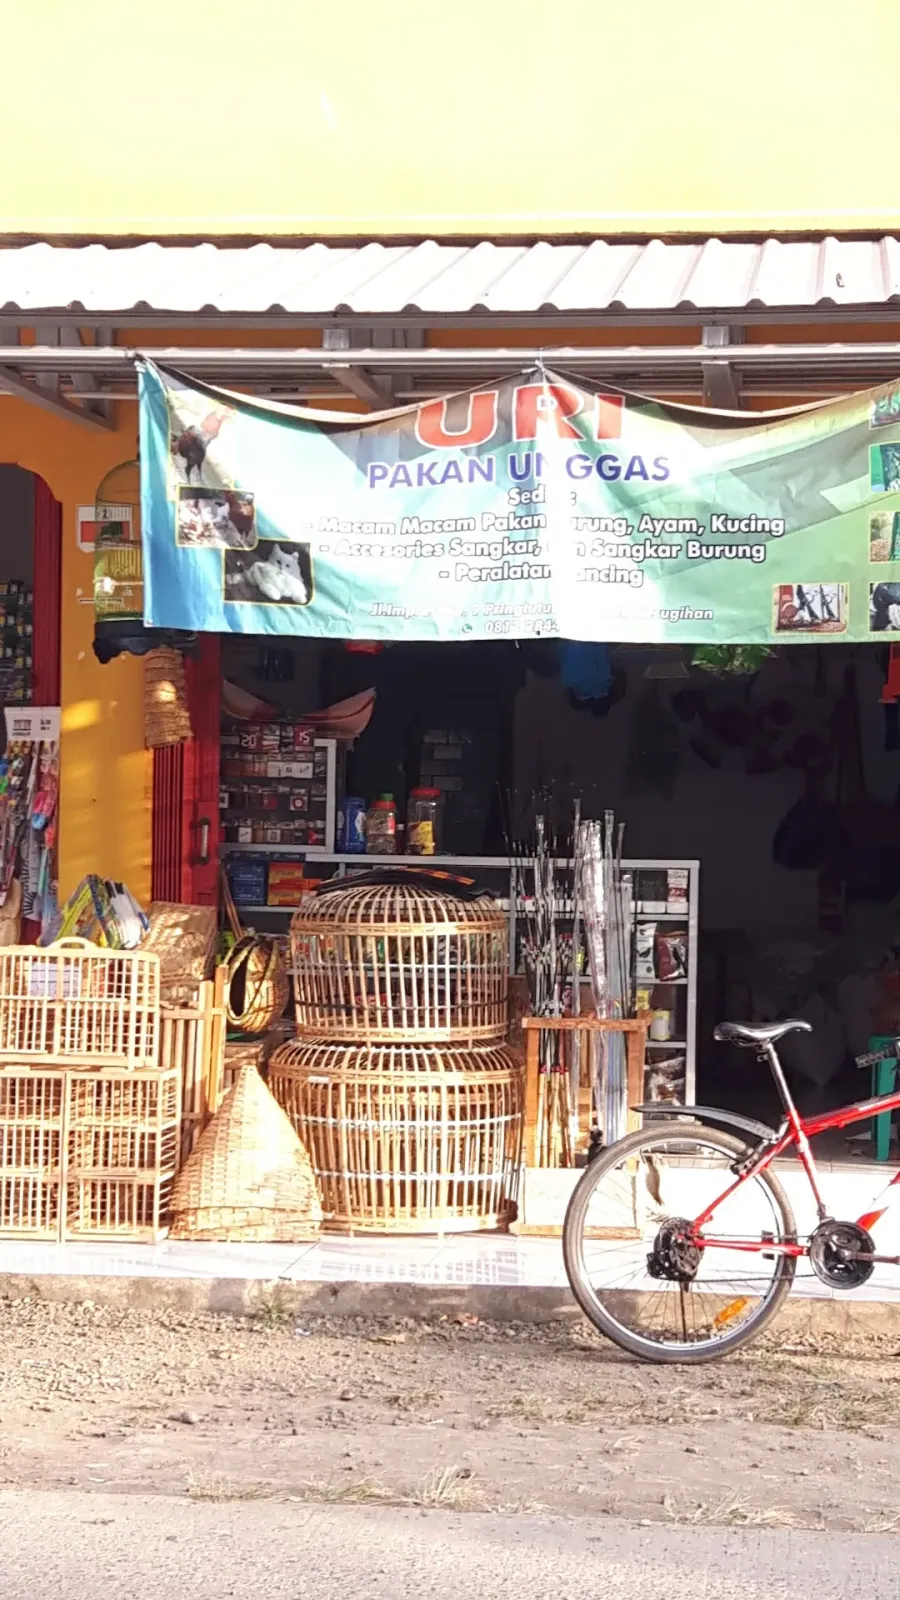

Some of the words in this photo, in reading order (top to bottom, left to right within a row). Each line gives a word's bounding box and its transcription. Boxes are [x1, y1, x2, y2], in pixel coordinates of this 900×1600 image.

[415, 384, 625, 449] URI
[368, 455, 493, 490] PAKAN
[318, 516, 396, 537] Macam
[400, 513, 476, 535] Macam
[481, 509, 547, 532] Pakan
[559, 514, 633, 538] urung,
[638, 513, 705, 539] Ayam,
[711, 513, 785, 536] Kucing
[449, 536, 541, 561] Sangkar,
[590, 539, 681, 561] Sangkar
[686, 541, 766, 563] Burung
[566, 564, 644, 587] ancing
[484, 601, 553, 618] Pringtutu
